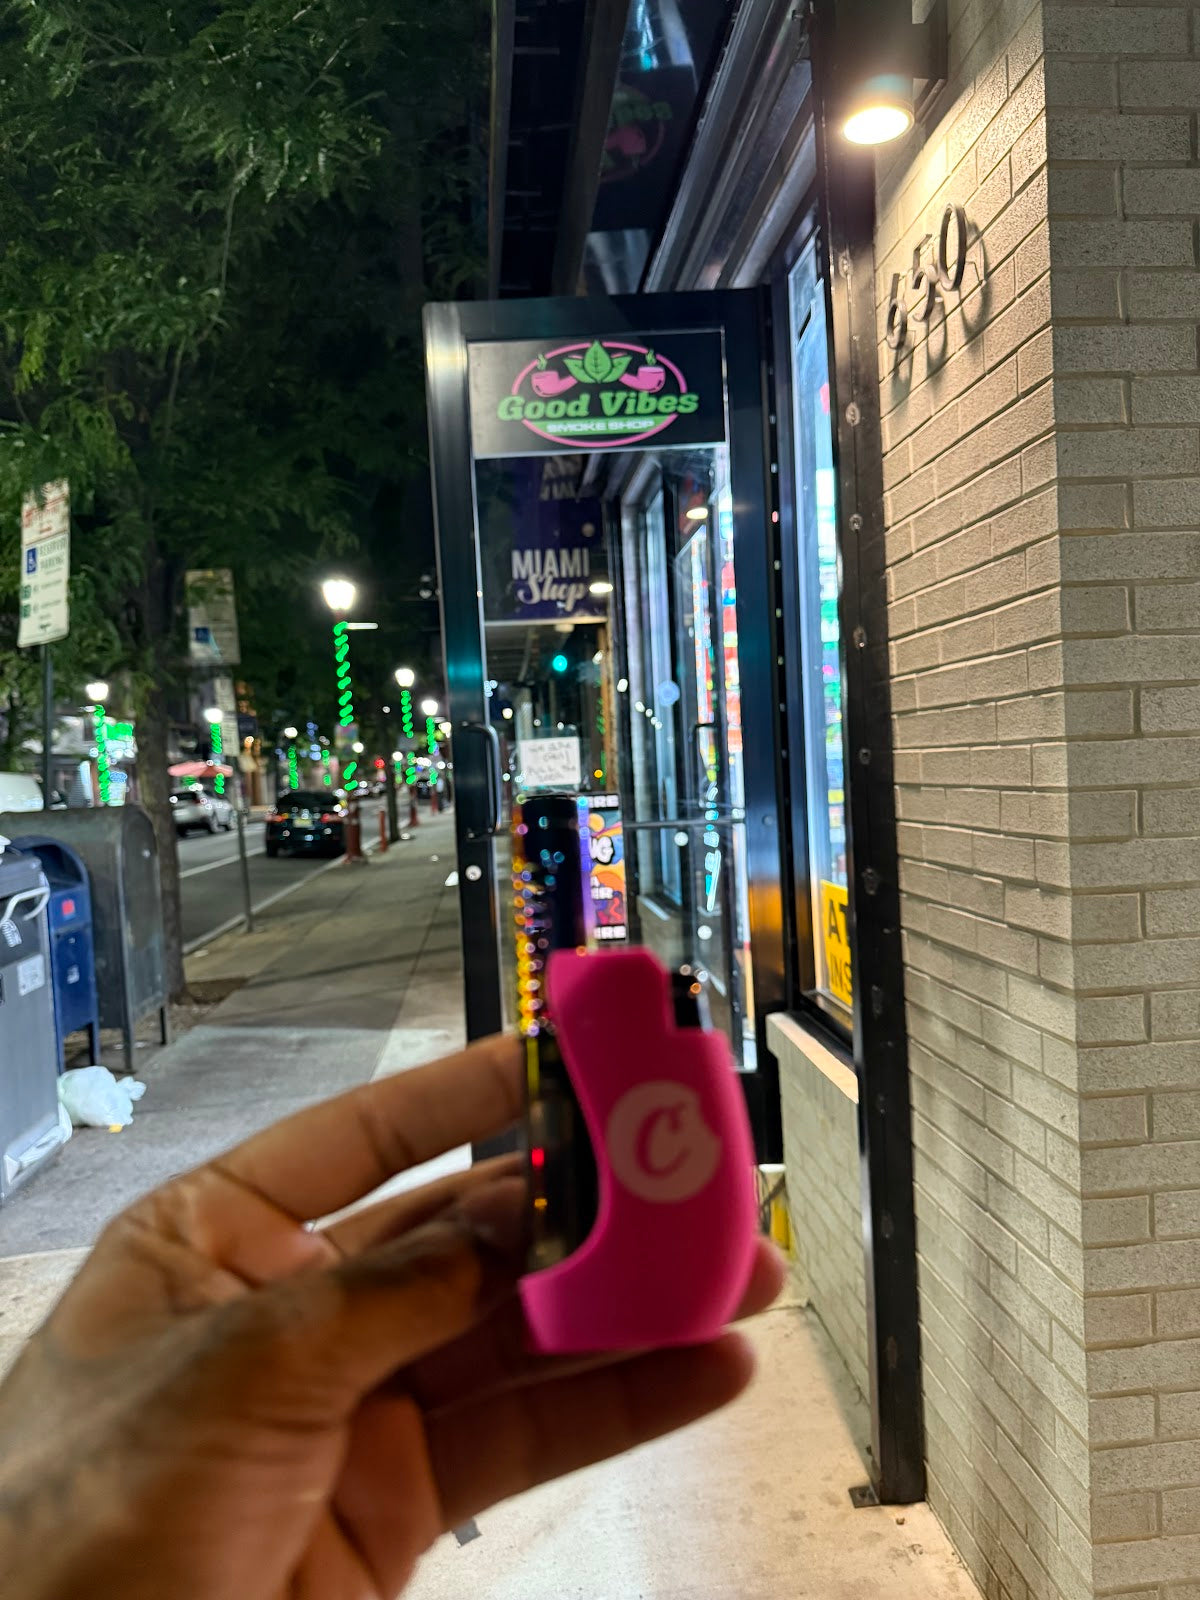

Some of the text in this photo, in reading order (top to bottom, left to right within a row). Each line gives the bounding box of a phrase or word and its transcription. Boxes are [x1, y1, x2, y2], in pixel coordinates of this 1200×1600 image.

[887, 203, 967, 350] 650
[497, 391, 699, 420] Good Vibes
[546, 418, 655, 434] SMOKE SHOP
[511, 547, 590, 580] MIAMI
